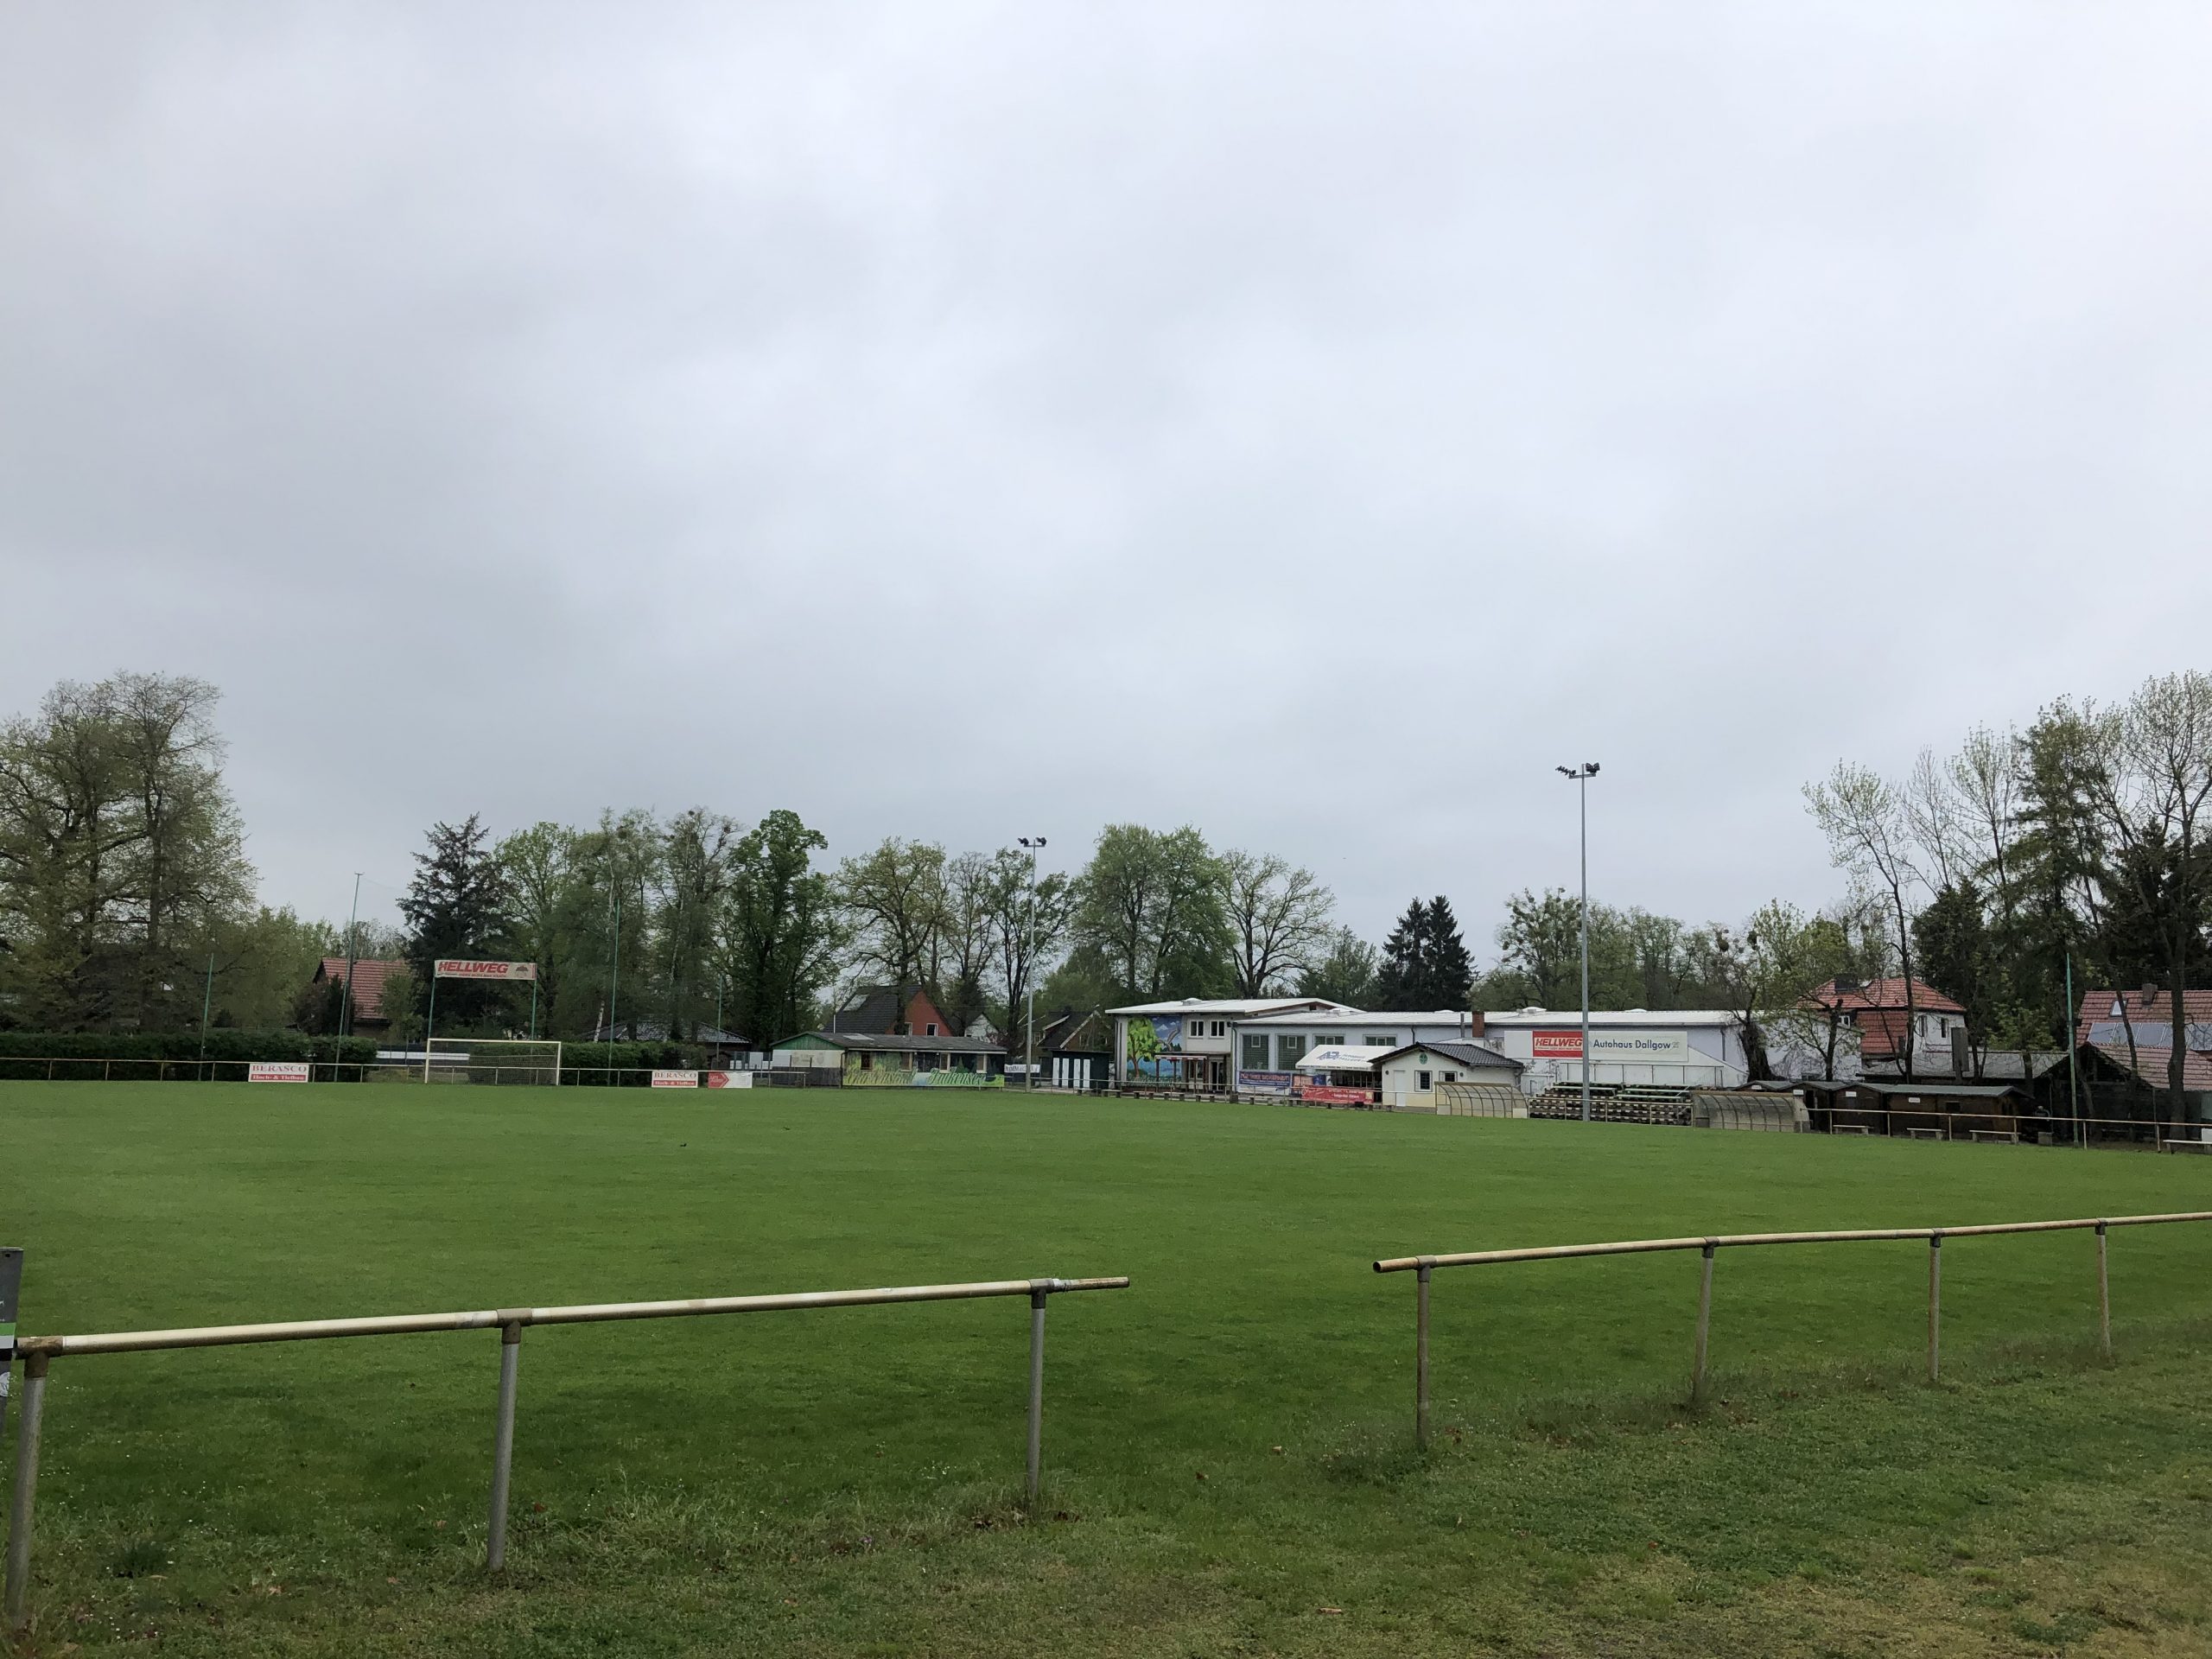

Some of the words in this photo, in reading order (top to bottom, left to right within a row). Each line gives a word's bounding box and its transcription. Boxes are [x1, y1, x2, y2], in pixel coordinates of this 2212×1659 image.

[438, 961, 509, 974] HELLWEG
[1535, 1038, 1583, 1047] HELLWEG
[1593, 1039, 1633, 1048] Autohaus
[1635, 1039, 1671, 1051] Dallgow
